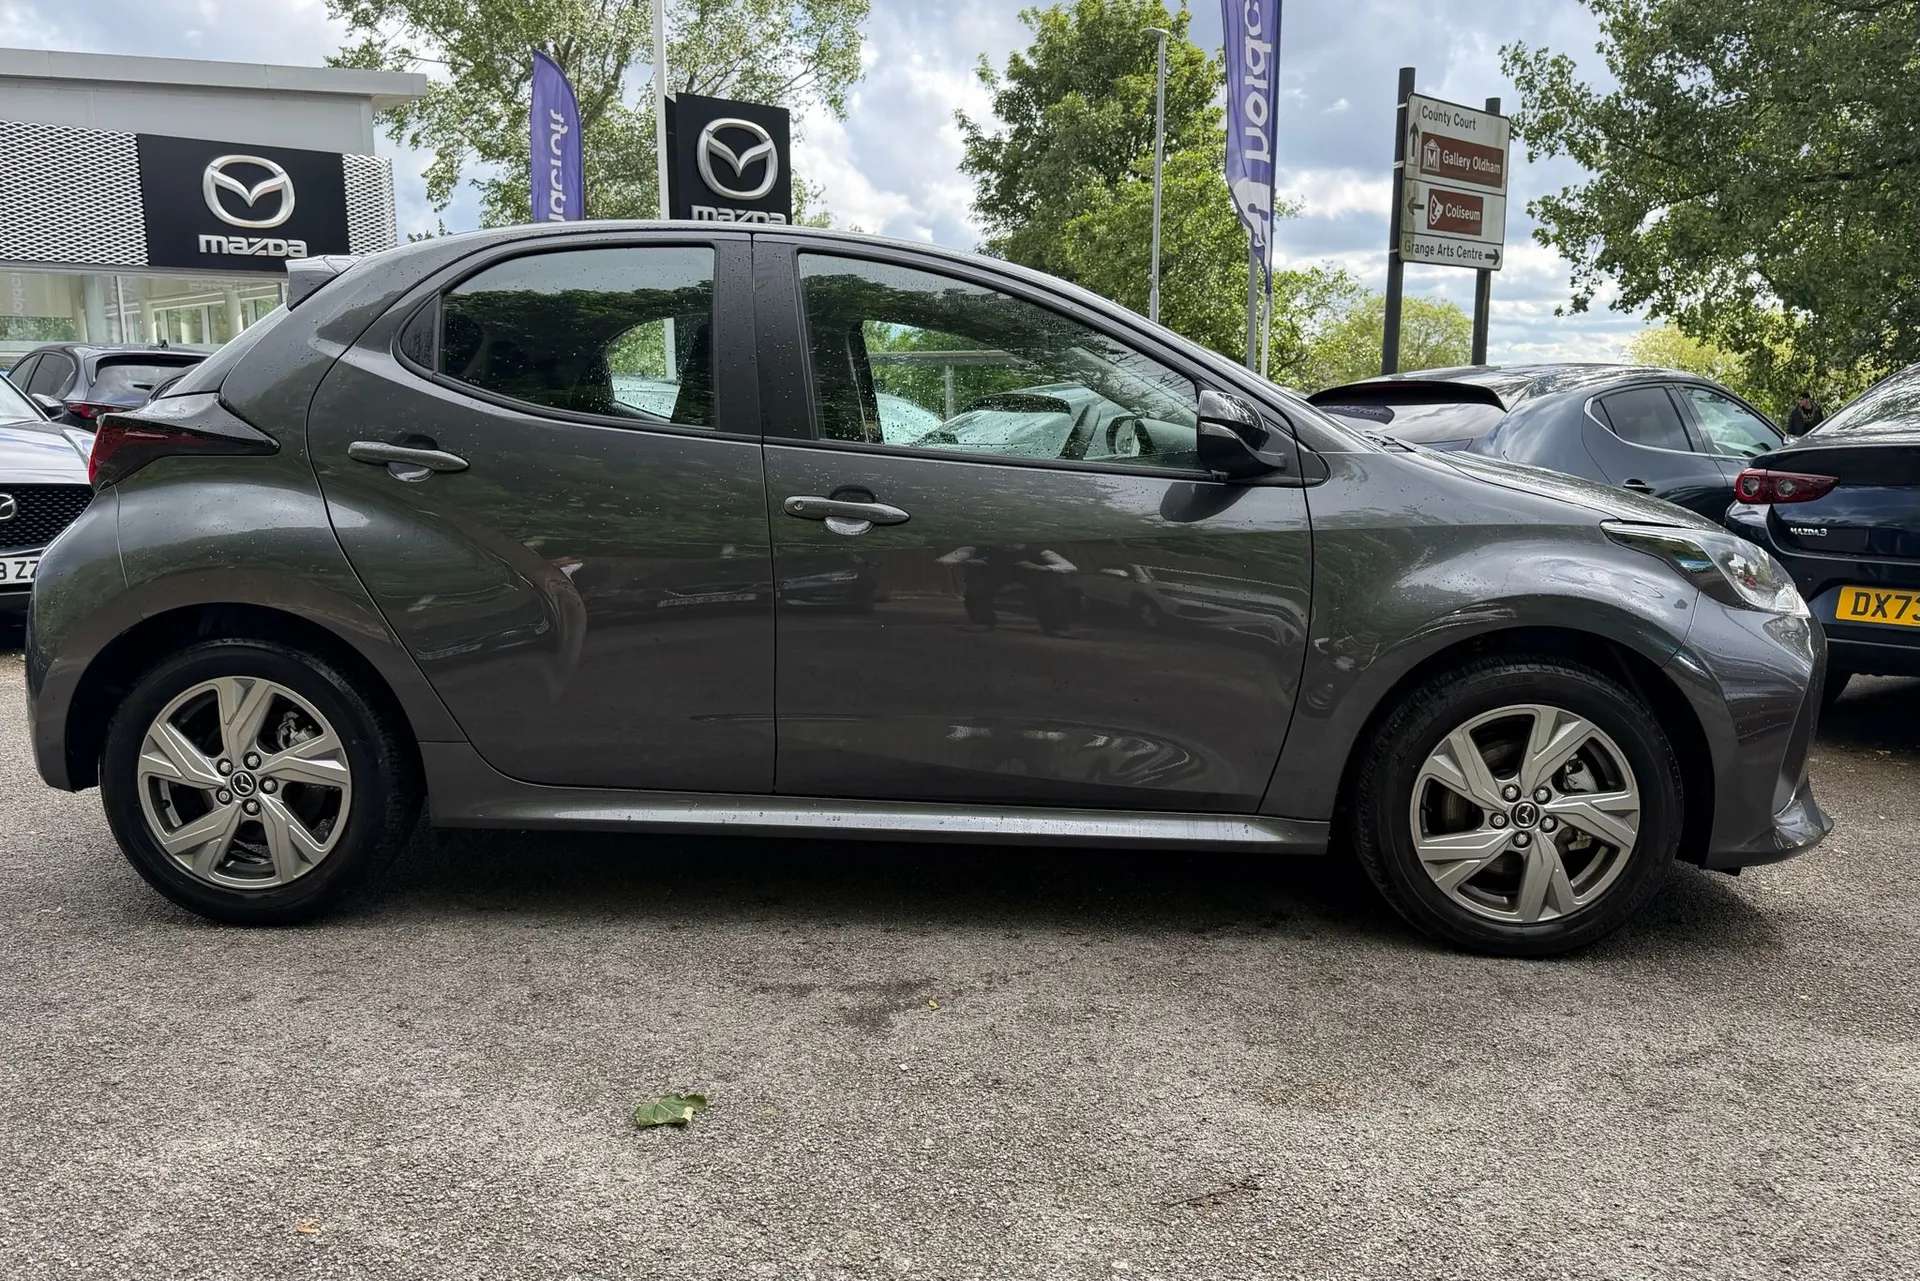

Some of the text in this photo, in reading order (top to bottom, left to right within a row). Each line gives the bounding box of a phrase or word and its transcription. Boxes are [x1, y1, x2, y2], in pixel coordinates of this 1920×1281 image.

[1421, 105, 1477, 130] County Court
[1442, 150, 1501, 174] Gallery Oldham
[1445, 203, 1481, 221] Coliseum
[1404, 240, 1483, 261] Grange Arts Centre
